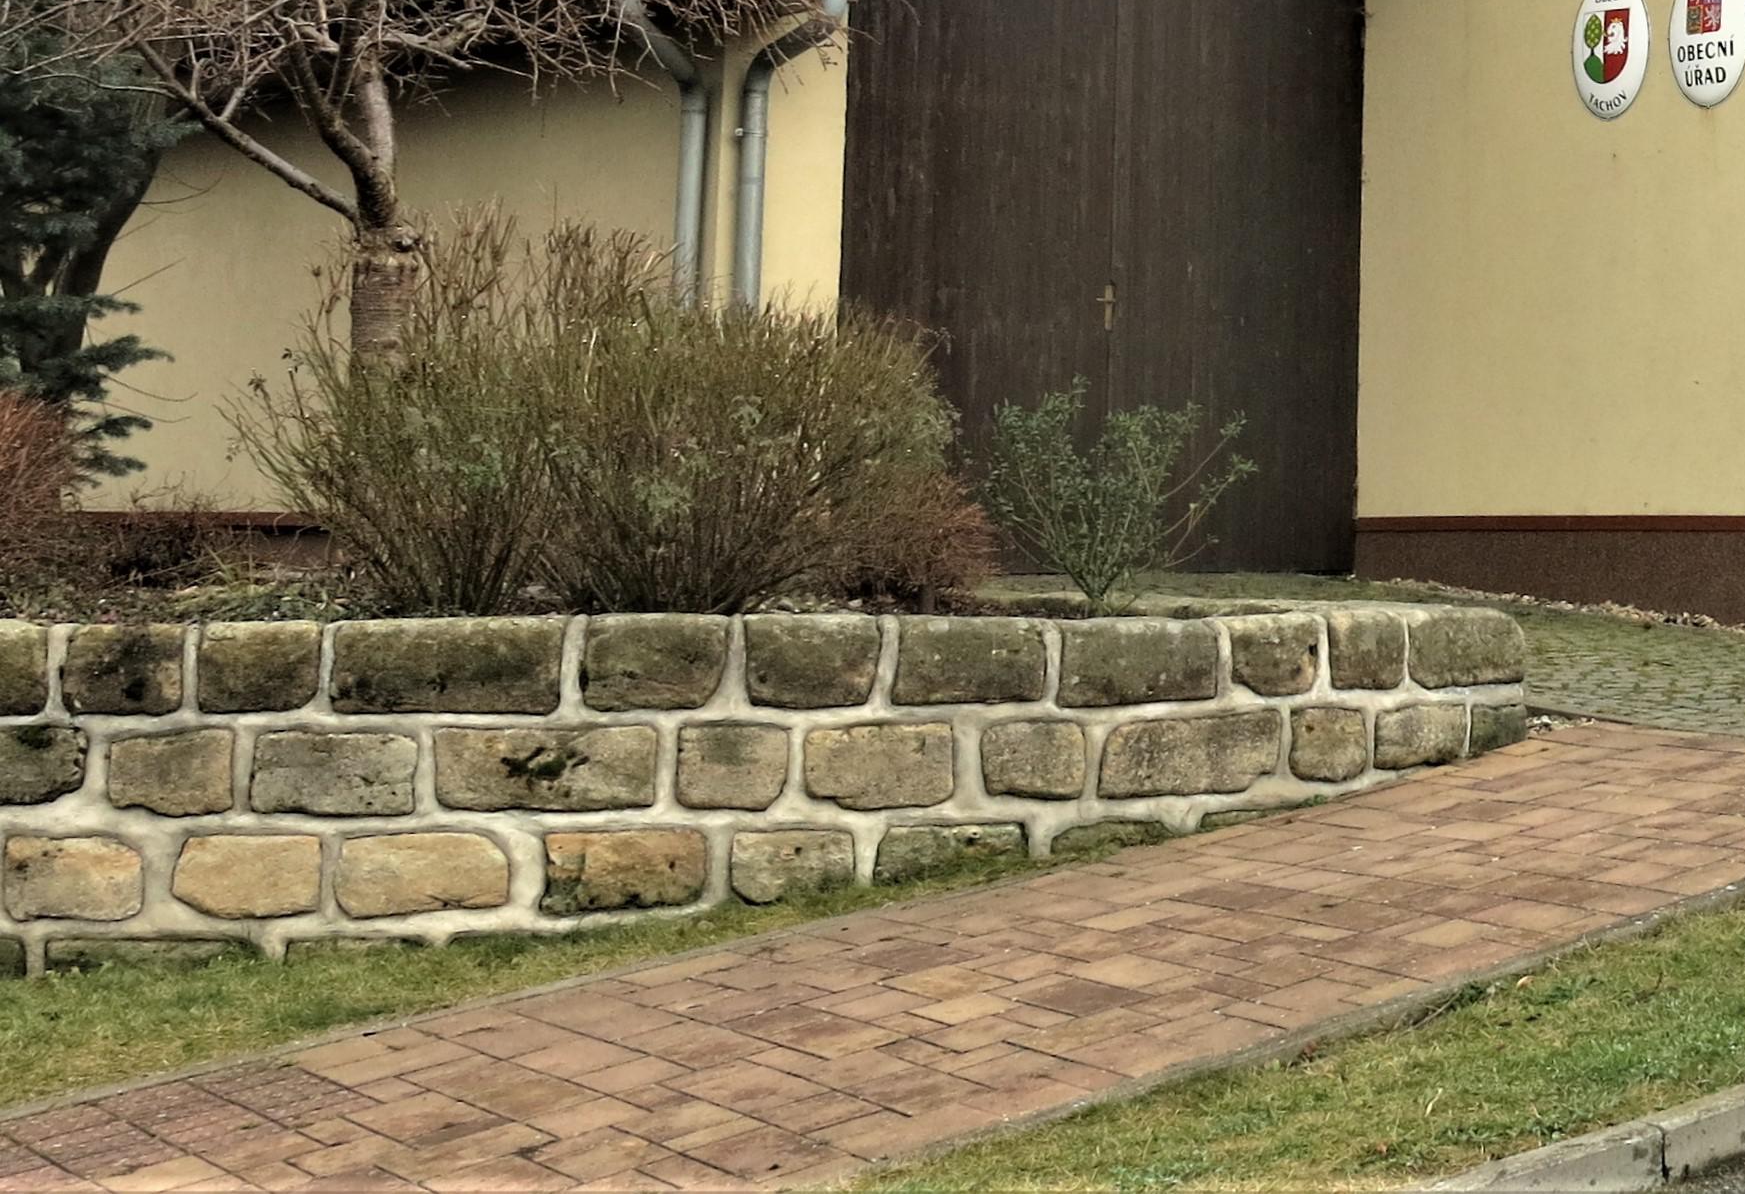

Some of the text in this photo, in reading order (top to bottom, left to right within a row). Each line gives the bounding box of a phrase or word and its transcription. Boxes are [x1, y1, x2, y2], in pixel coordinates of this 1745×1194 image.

[1677, 34, 1735, 63] OBECNÍ
[1685, 64, 1726, 87] ÚŘAD
[1589, 89, 1628, 111] TACHOV
